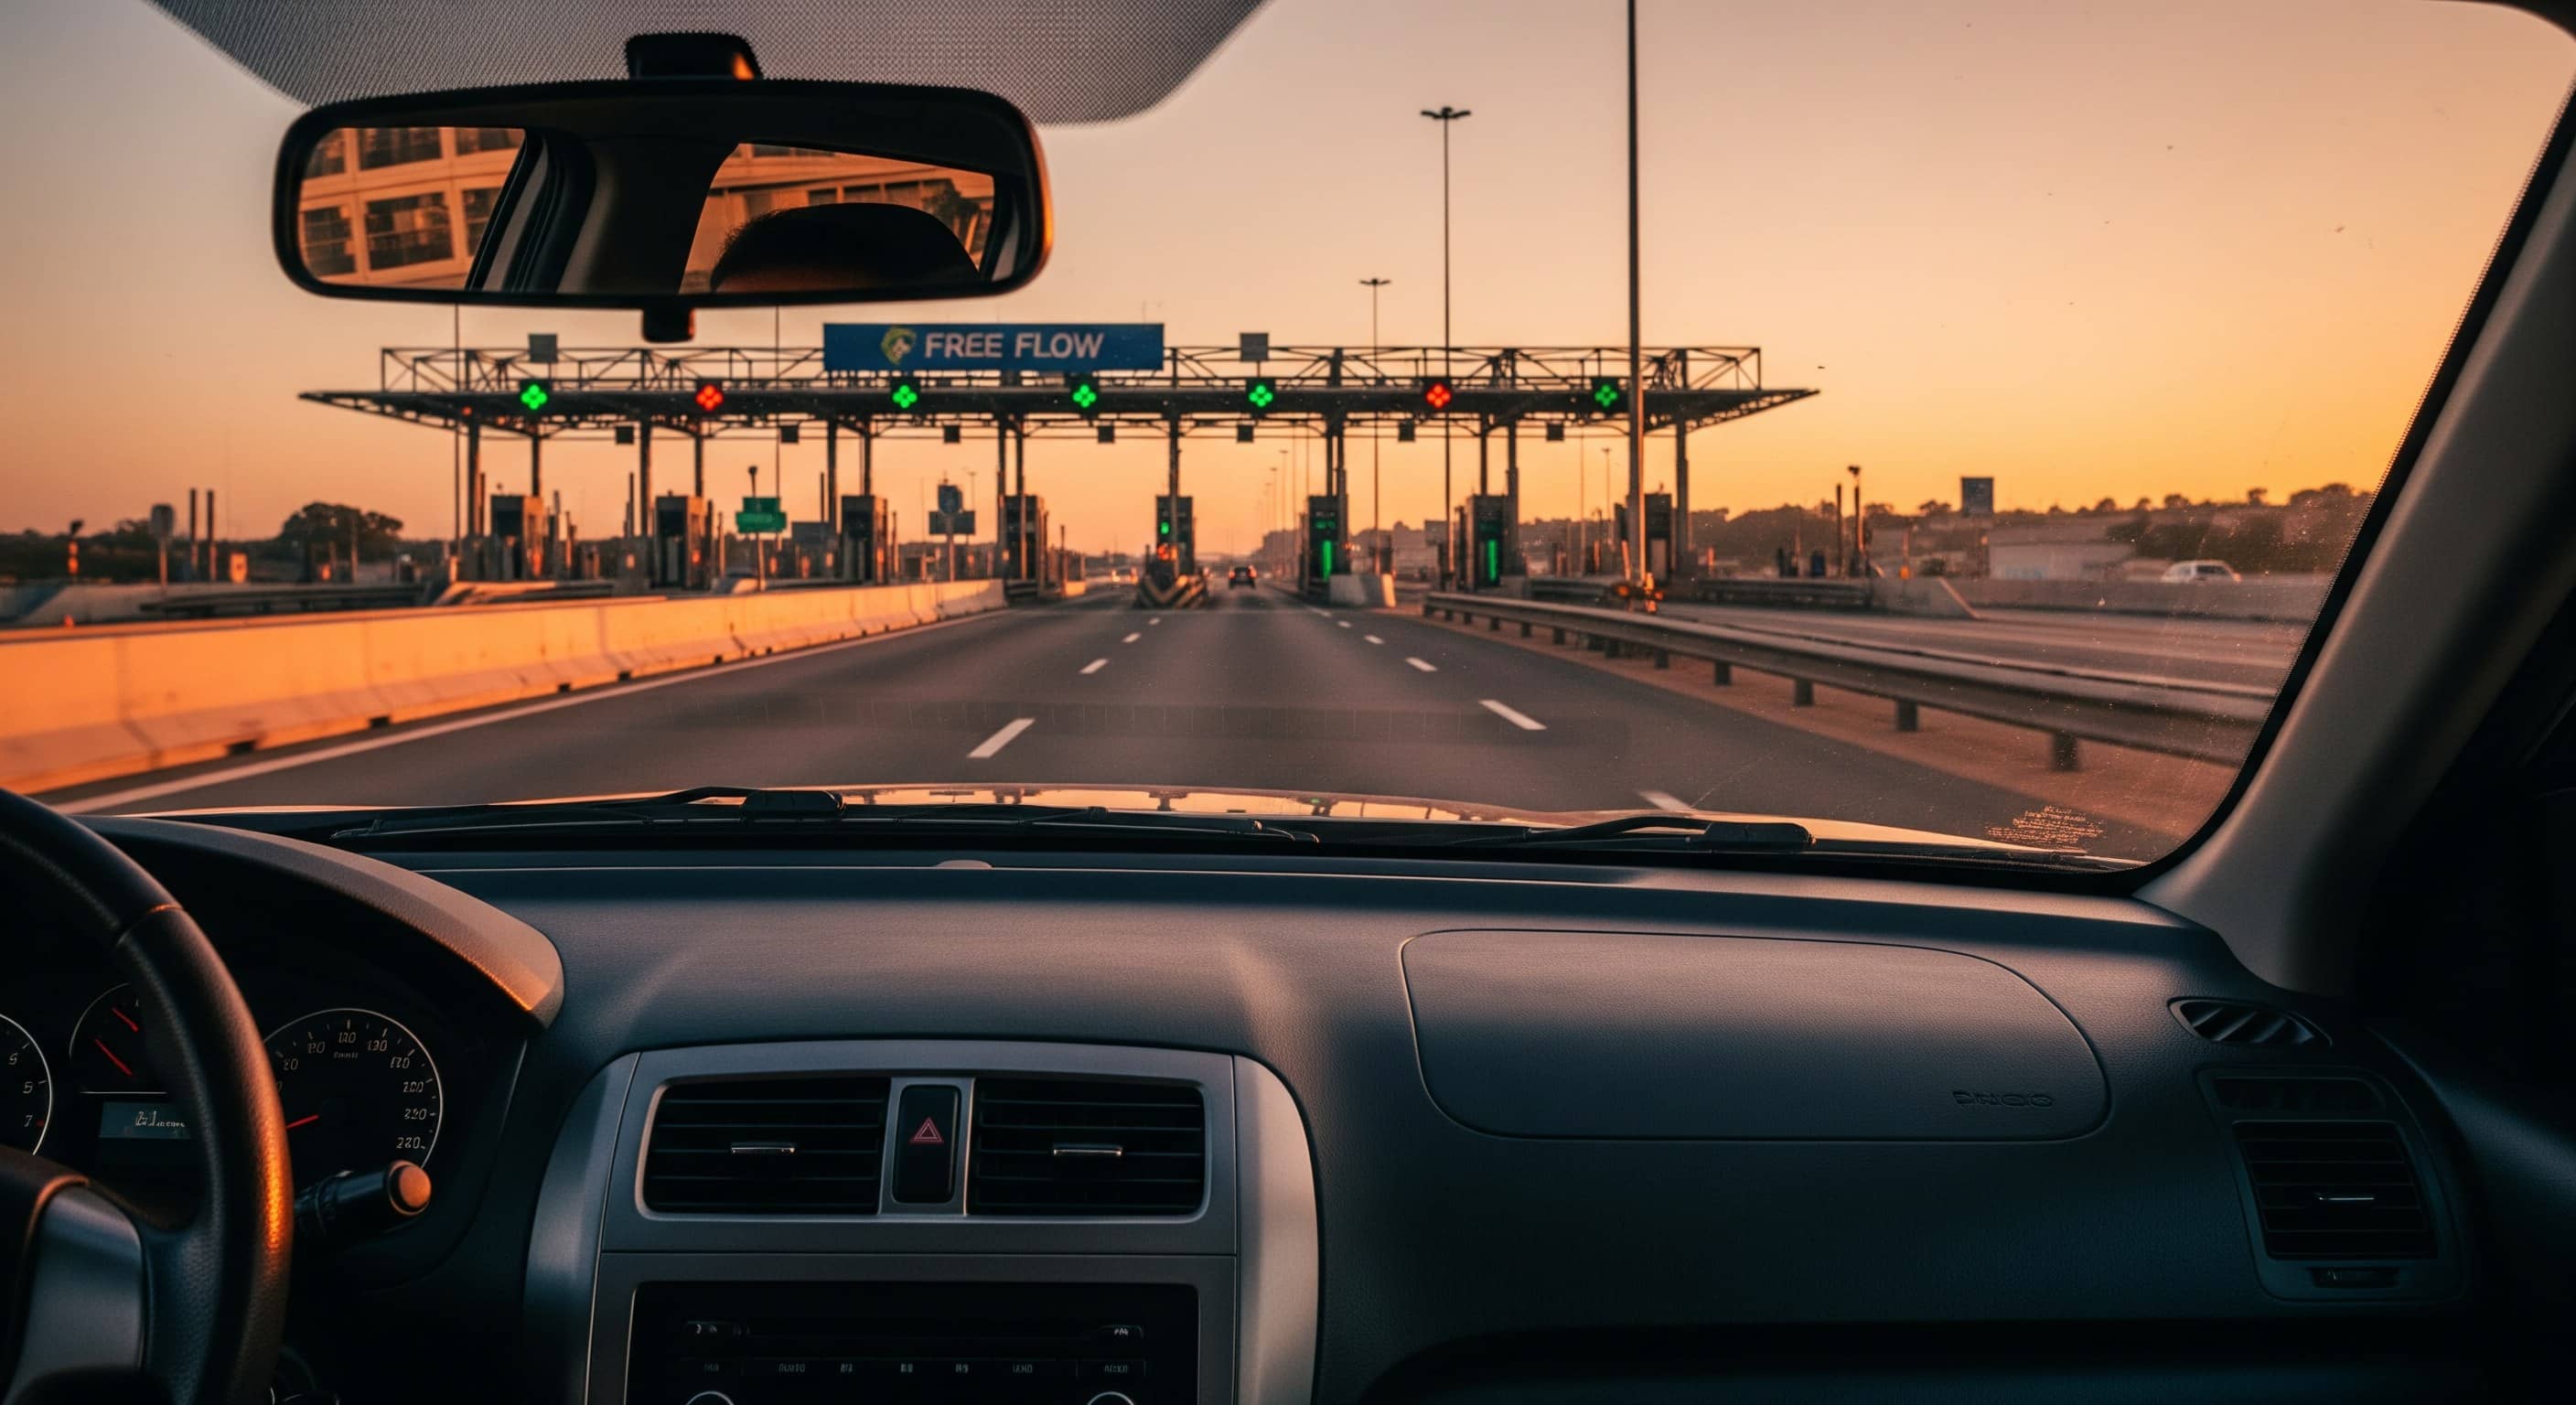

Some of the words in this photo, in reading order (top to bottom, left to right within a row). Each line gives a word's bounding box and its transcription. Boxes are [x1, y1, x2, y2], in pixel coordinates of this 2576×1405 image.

[925, 332, 1004, 358] FREE
[1014, 332, 1104, 359] FLOW
[24, 1114, 34, 1128] 7
